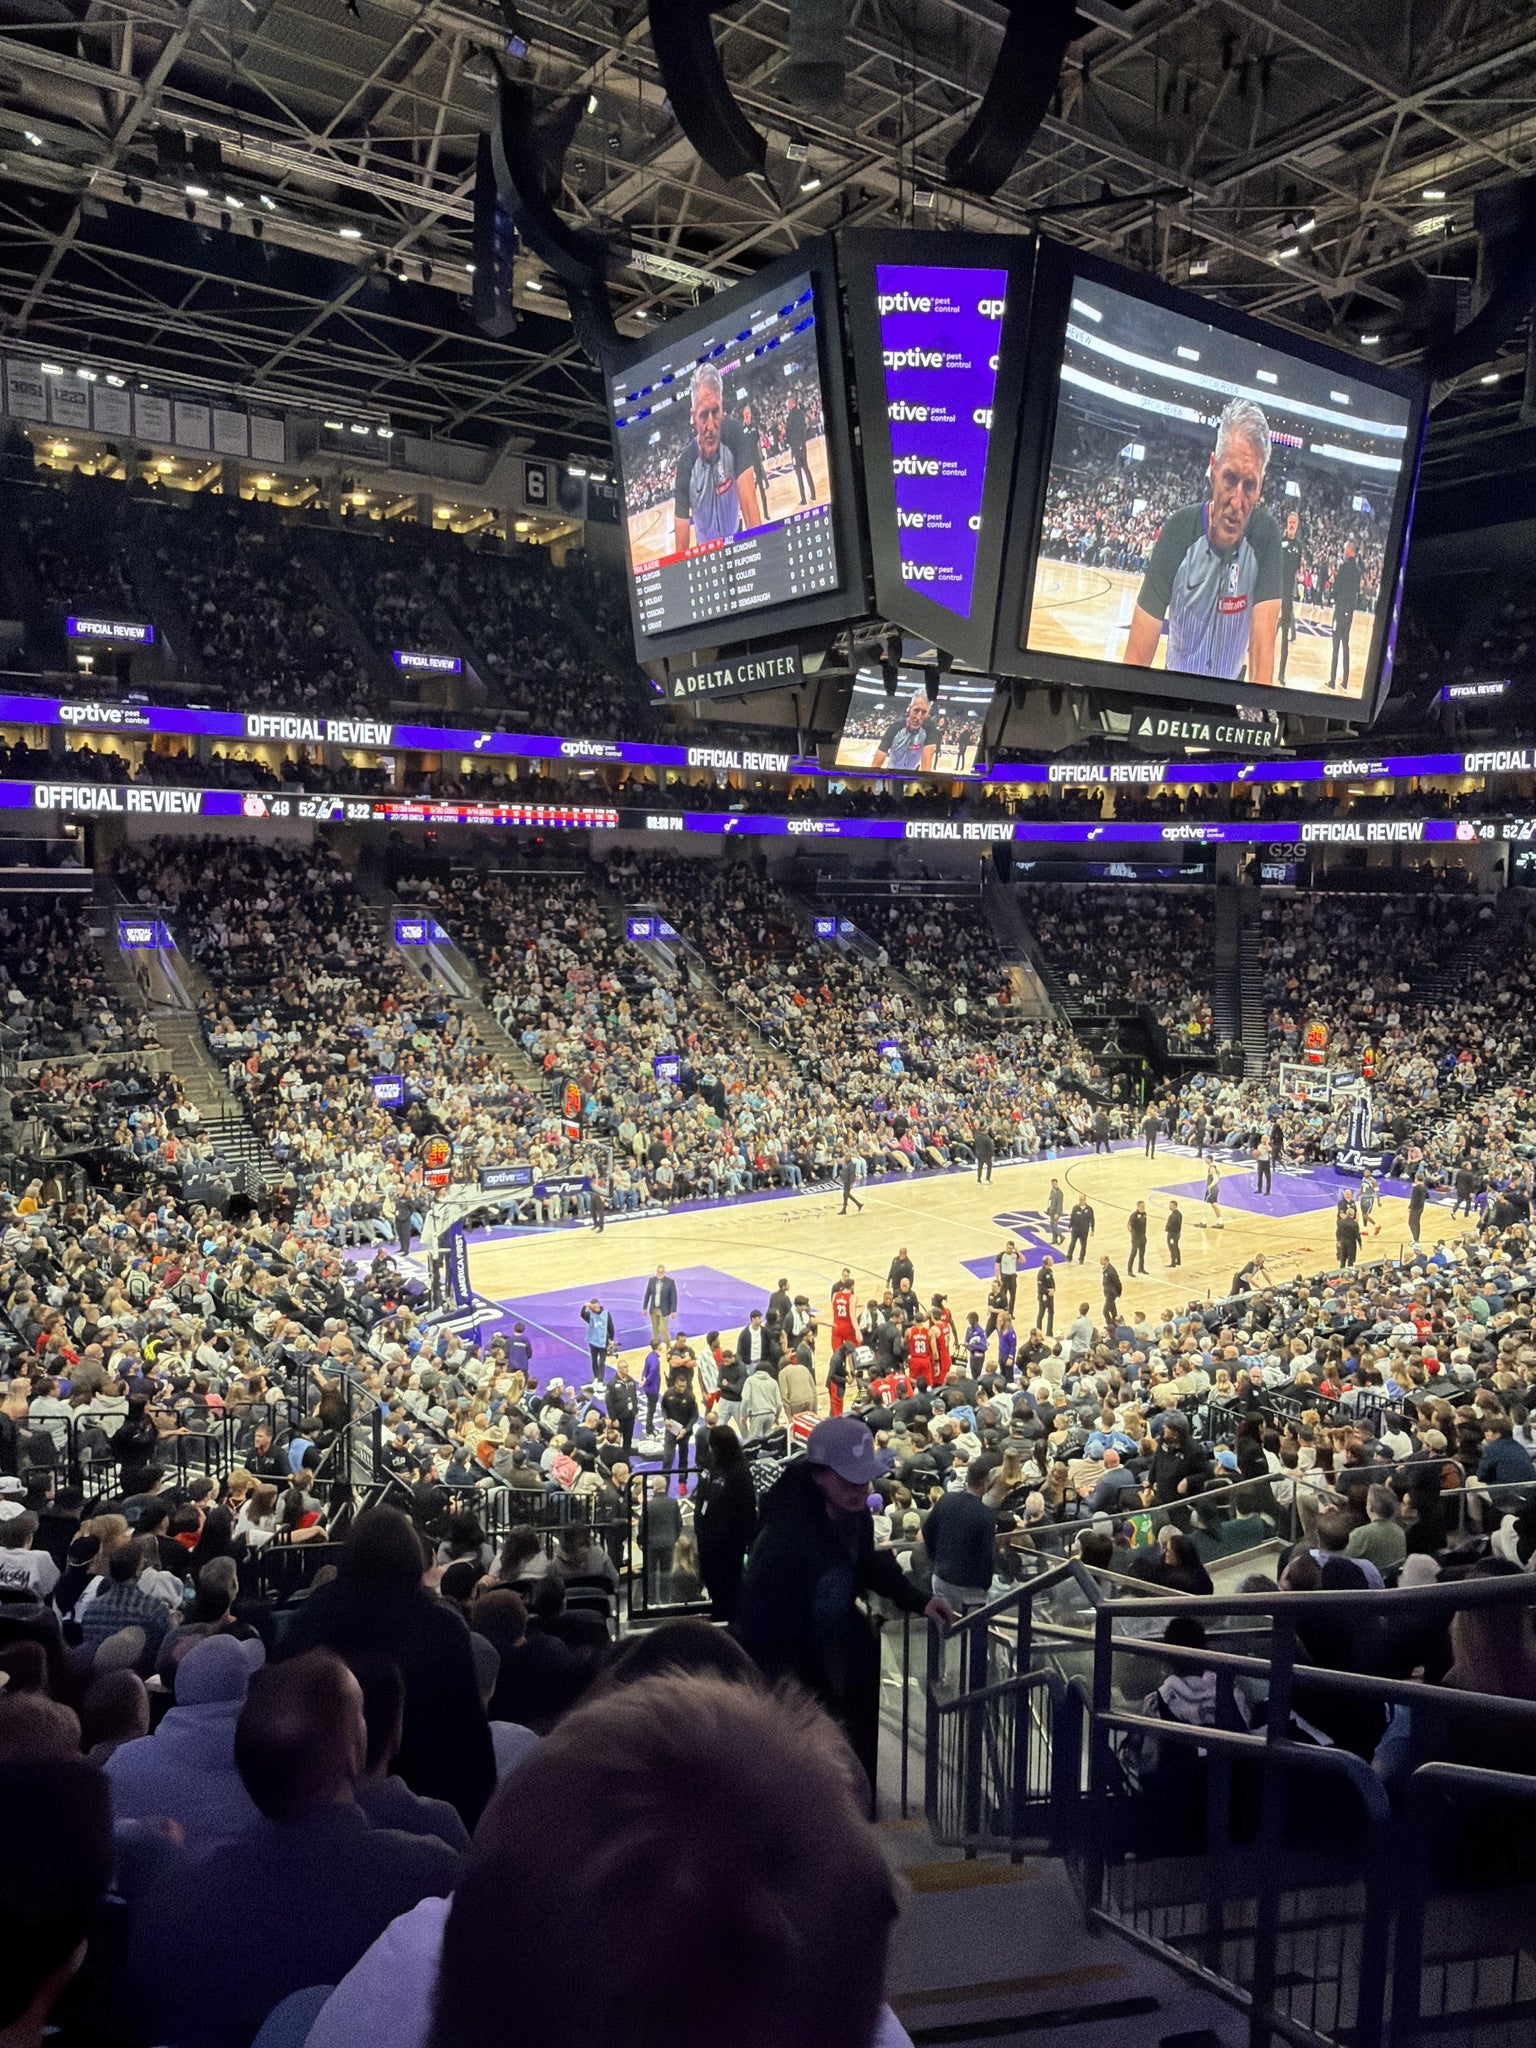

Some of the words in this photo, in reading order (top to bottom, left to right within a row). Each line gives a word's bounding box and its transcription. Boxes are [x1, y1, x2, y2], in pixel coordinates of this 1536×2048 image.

[935, 297, 950, 305] pest
[883, 347, 943, 371] aptive
[946, 353, 962, 361] pest
[946, 361, 971, 369] control
[888, 401, 928, 421] tive
[931, 407, 946, 415] pest
[942, 461, 957, 469] pest
[942, 469, 967, 477] control
[528, 470, 544, 498] 6
[824, 517, 829, 526] 0
[897, 507, 923, 528] ive
[927, 513, 942, 521] pest
[927, 521, 951, 529] control
[736, 568, 756, 580] COLLIER
[901, 561, 935, 581] tive
[938, 566, 953, 574] pest
[77, 622, 113, 635] OFFICIAL
[114, 625, 145, 638] REVIEW
[401, 655, 429, 667] OFFICIAL
[430, 658, 454, 669] REVIEW
[687, 669, 734, 693] DELTA
[737, 656, 795, 683] CENTER
[1450, 686, 1477, 697] OFFICIAL
[1478, 683, 1504, 693] REVIEW
[59, 703, 122, 725] aptive
[125, 710, 140, 718] pest
[125, 717, 149, 725] control
[247, 714, 324, 741] OFFICIAL
[327, 720, 392, 745] REVIEW
[1157, 719, 1210, 740] DELTA
[1216, 725, 1272, 747] CENTER
[561, 740, 604, 757] aptive
[688, 748, 741, 769] OFFICIAL
[743, 752, 788, 772] REVIEW
[1464, 751, 1531, 772] OFFICIAL
[1049, 766, 1108, 782] OFFICIAL
[1110, 765, 1165, 782] REVIEW
[1323, 760, 1368, 778] aptive
[35, 785, 123, 811] OFFICIAL
[126, 790, 201, 814] REVIEW
[271, 801, 289, 816] 48
[299, 802, 316, 817] 52
[347, 803, 369, 819] 3:22
[670, 817, 683, 830] PM
[787, 819, 824, 834] aptive
[905, 822, 961, 839] OFFICIAL
[963, 823, 1014, 840] REVIEW
[1162, 825, 1205, 841] aptive
[1302, 823, 1366, 841] OFFICIAL
[1367, 822, 1423, 841] REVIEW
[1479, 825, 1495, 838] 48
[1503, 825, 1517, 838] 52
[1269, 843, 1307, 857] G2G
[429, 1153, 445, 1166] 24
[487, 1172, 515, 1183] aptive
[455, 1234, 464, 1259] FIRST
[457, 1259, 468, 1297] AMERICA
[837, 1304, 847, 1317] 23
[914, 1340, 926, 1353] 33
